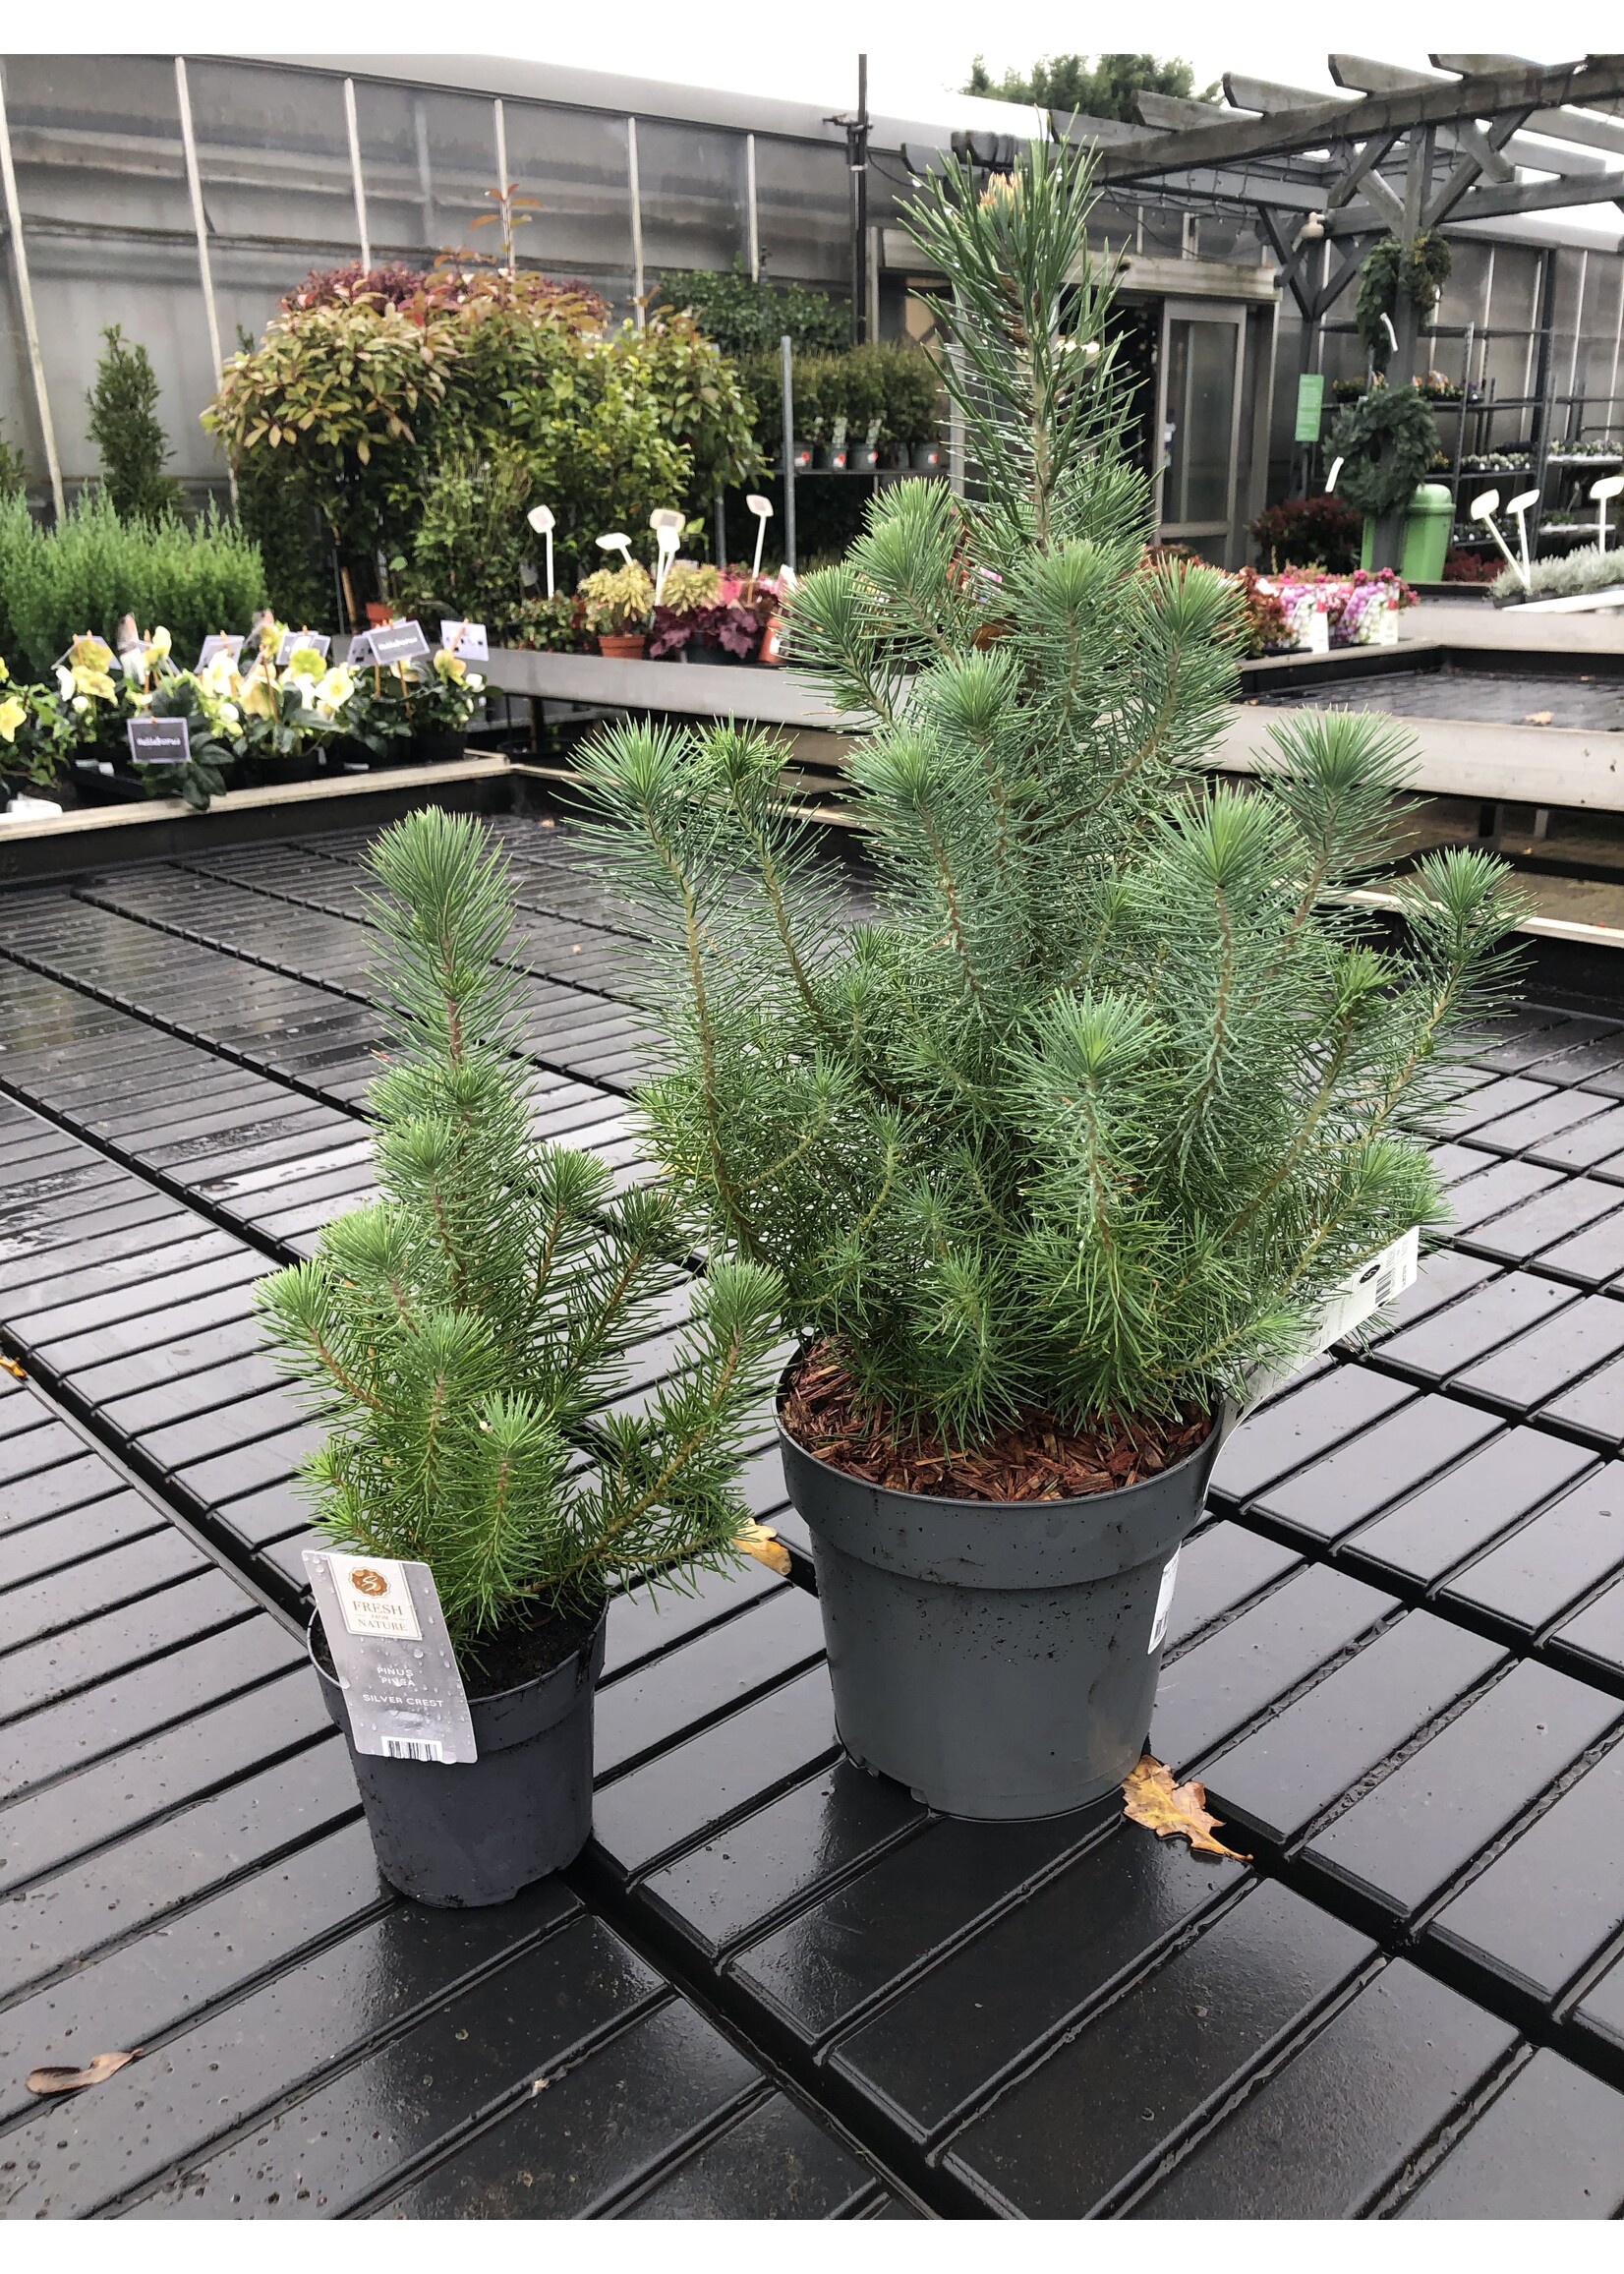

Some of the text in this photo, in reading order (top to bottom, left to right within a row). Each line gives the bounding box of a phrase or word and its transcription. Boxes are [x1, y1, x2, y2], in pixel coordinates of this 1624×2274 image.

[352, 1601, 403, 1616] FRESH
[357, 1618, 408, 1632] NATURE
[377, 1666, 414, 1678] PINUS
[362, 1694, 444, 1708] SILVER CREST
